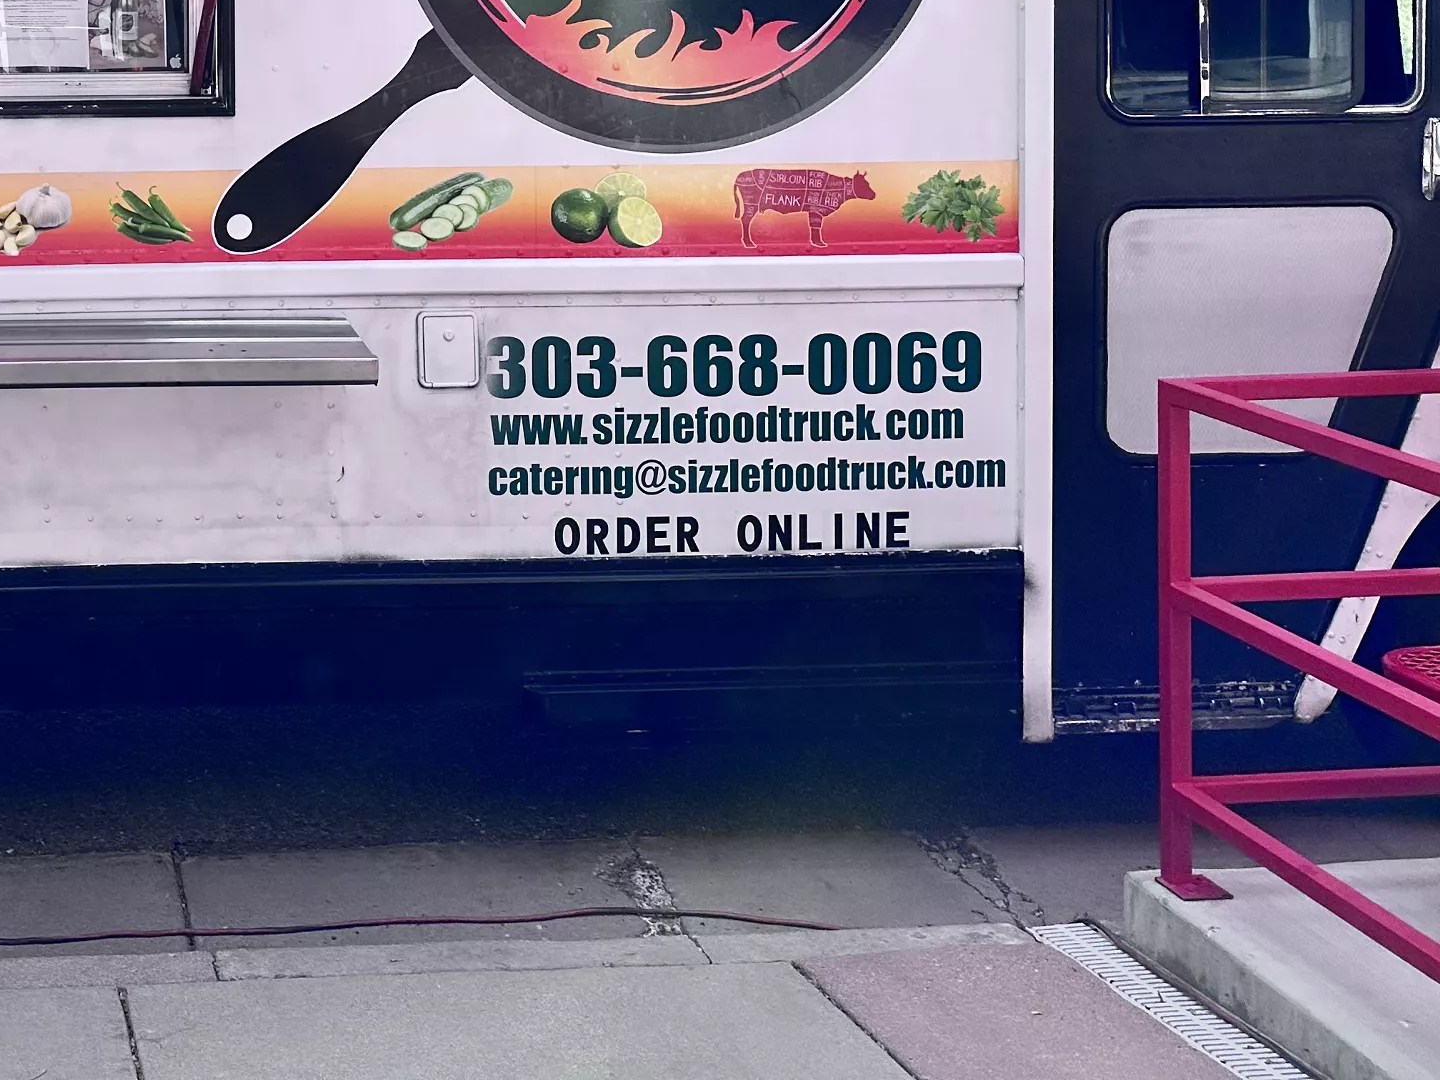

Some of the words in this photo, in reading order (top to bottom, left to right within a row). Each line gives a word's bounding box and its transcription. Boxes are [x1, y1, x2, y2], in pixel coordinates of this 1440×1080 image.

[769, 173, 806, 185] SIRLOIN
[808, 179, 823, 188] RIB
[764, 193, 802, 207] FLANK
[824, 197, 839, 208] RIB
[486, 331, 983, 399] 303-668-0069
[491, 404, 965, 446] www.sizzlefoodtruck.com
[488, 456, 1007, 499] catering@sizzlefoodtruck.com
[554, 517, 700, 555] ORDER
[737, 511, 911, 552] ONLINE
